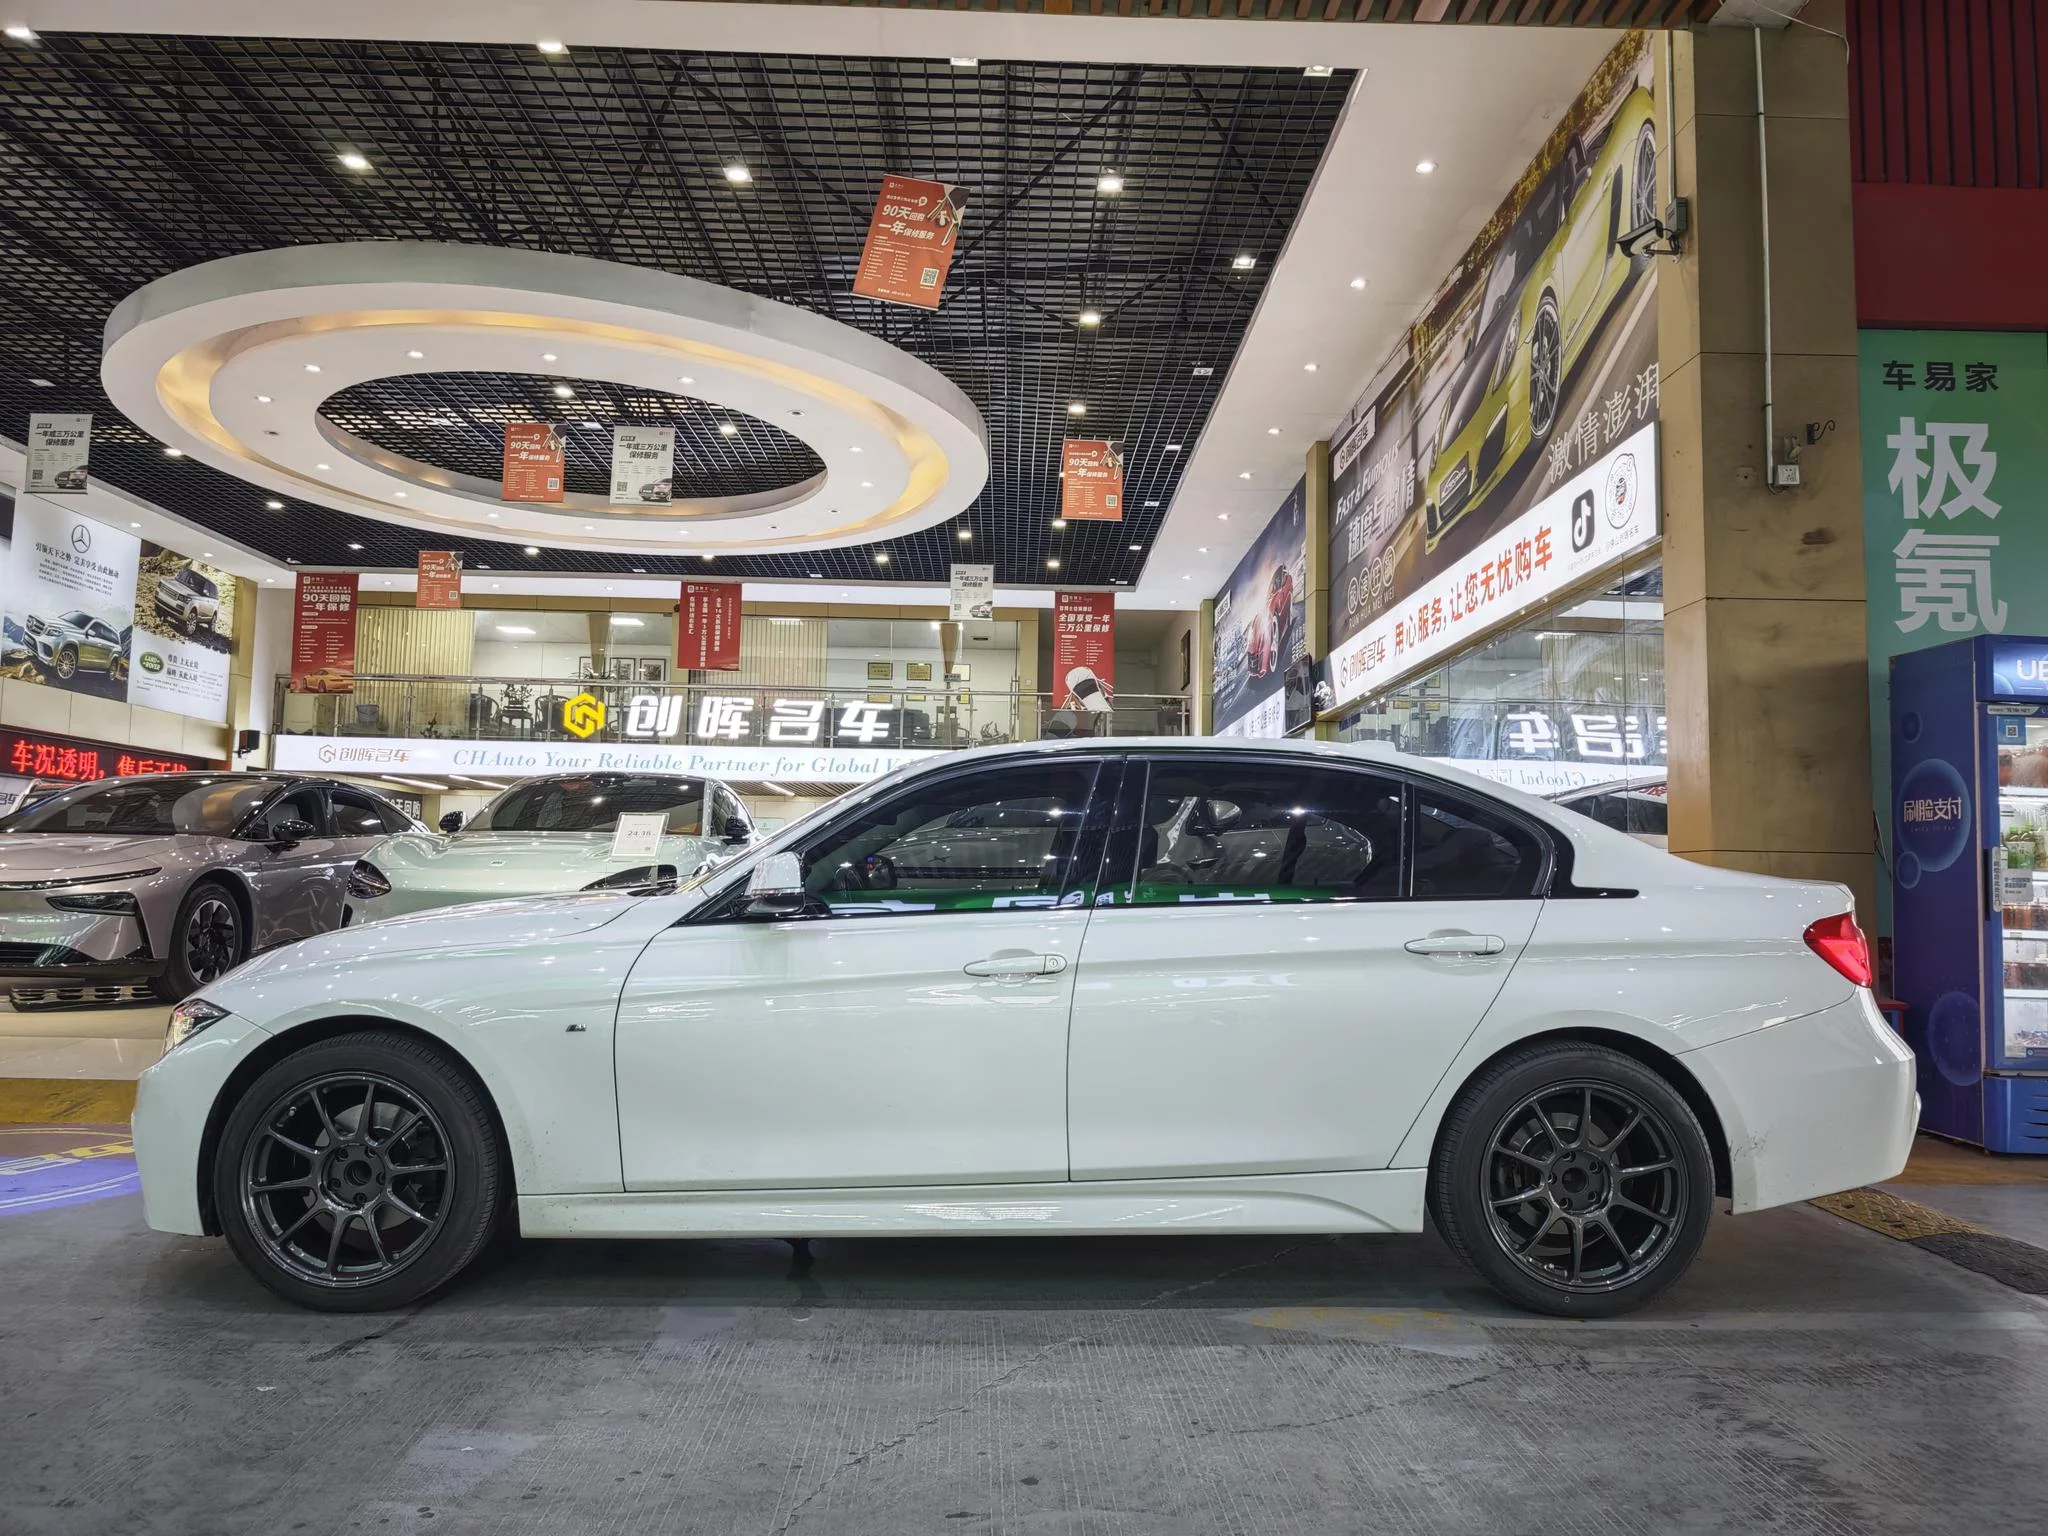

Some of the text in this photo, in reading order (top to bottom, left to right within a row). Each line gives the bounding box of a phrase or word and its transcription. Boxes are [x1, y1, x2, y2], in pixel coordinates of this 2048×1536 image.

[1882, 360, 1999, 392] 车易家
[1887, 417, 2008, 634] 极氪
[302, 593, 351, 602] 90天回购
[626, 694, 894, 742] 创晖名车
[340, 747, 409, 763] 创晖名车
[453, 749, 535, 767] CHAuto
[544, 751, 592, 769] Your
[598, 753, 682, 771] Reliable
[688, 754, 767, 773] Partner
[771, 755, 805, 777] for
[811, 756, 879, 774] Global
[1903, 796, 1962, 823] 刷脸支付
